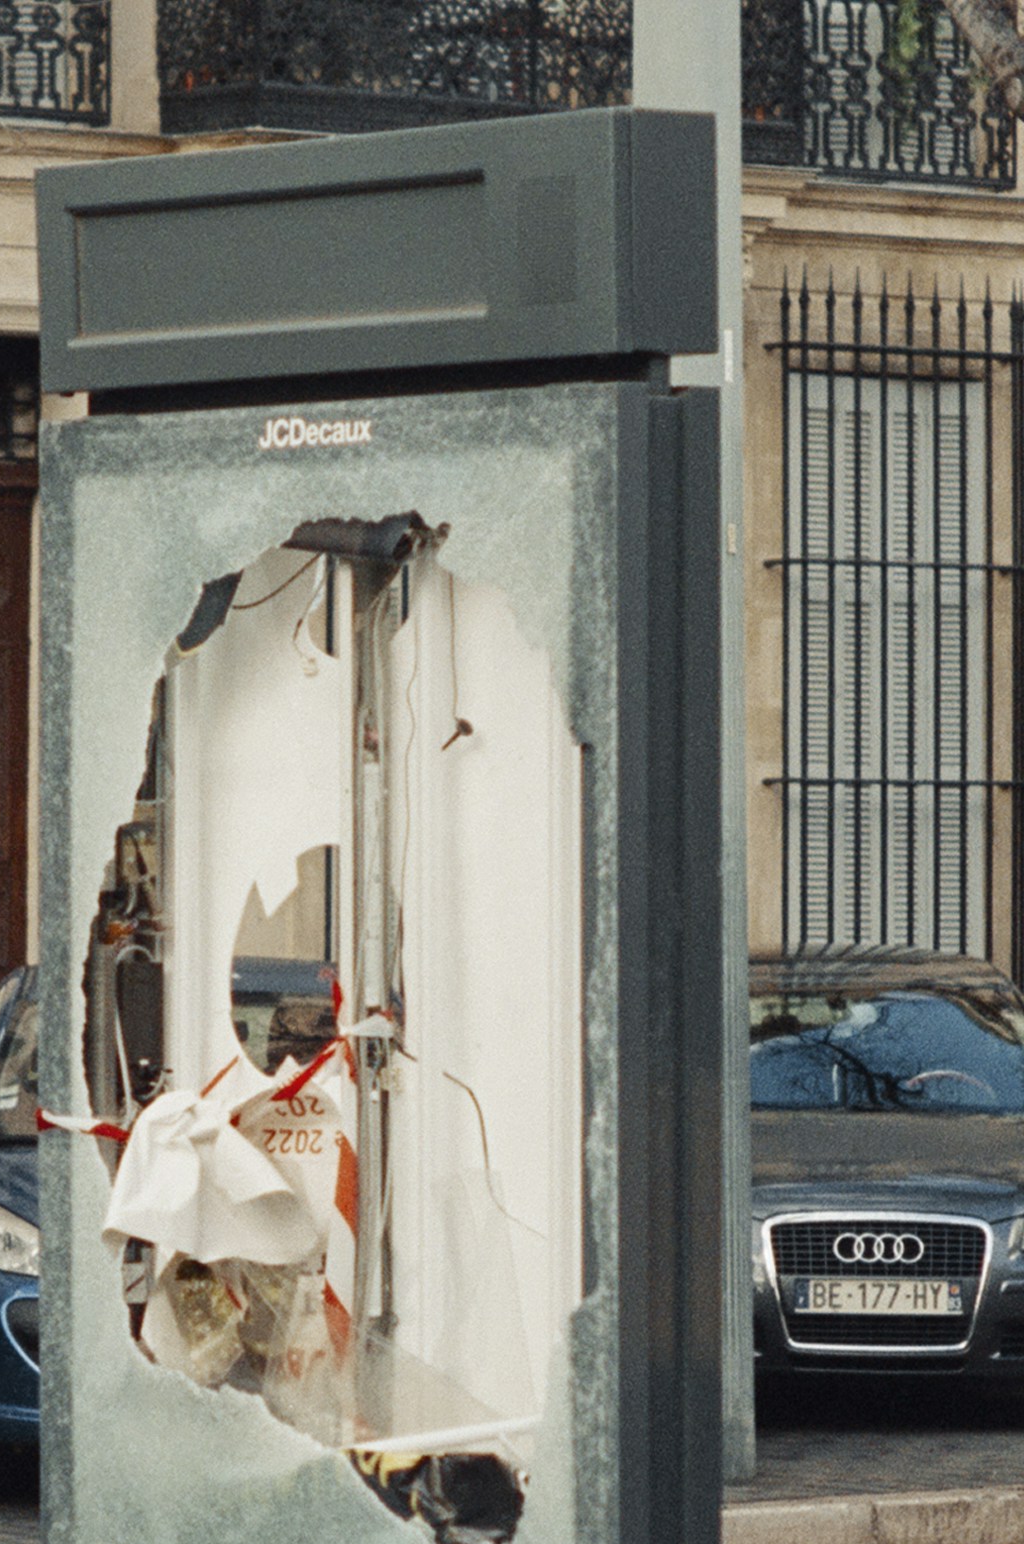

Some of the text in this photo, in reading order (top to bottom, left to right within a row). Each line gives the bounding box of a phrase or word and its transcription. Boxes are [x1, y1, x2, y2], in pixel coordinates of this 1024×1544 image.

[259, 418, 372, 448] JCDecaux
[263, 1129, 323, 1154] 2022
[812, 1283, 942, 1310] BE-177-HY
